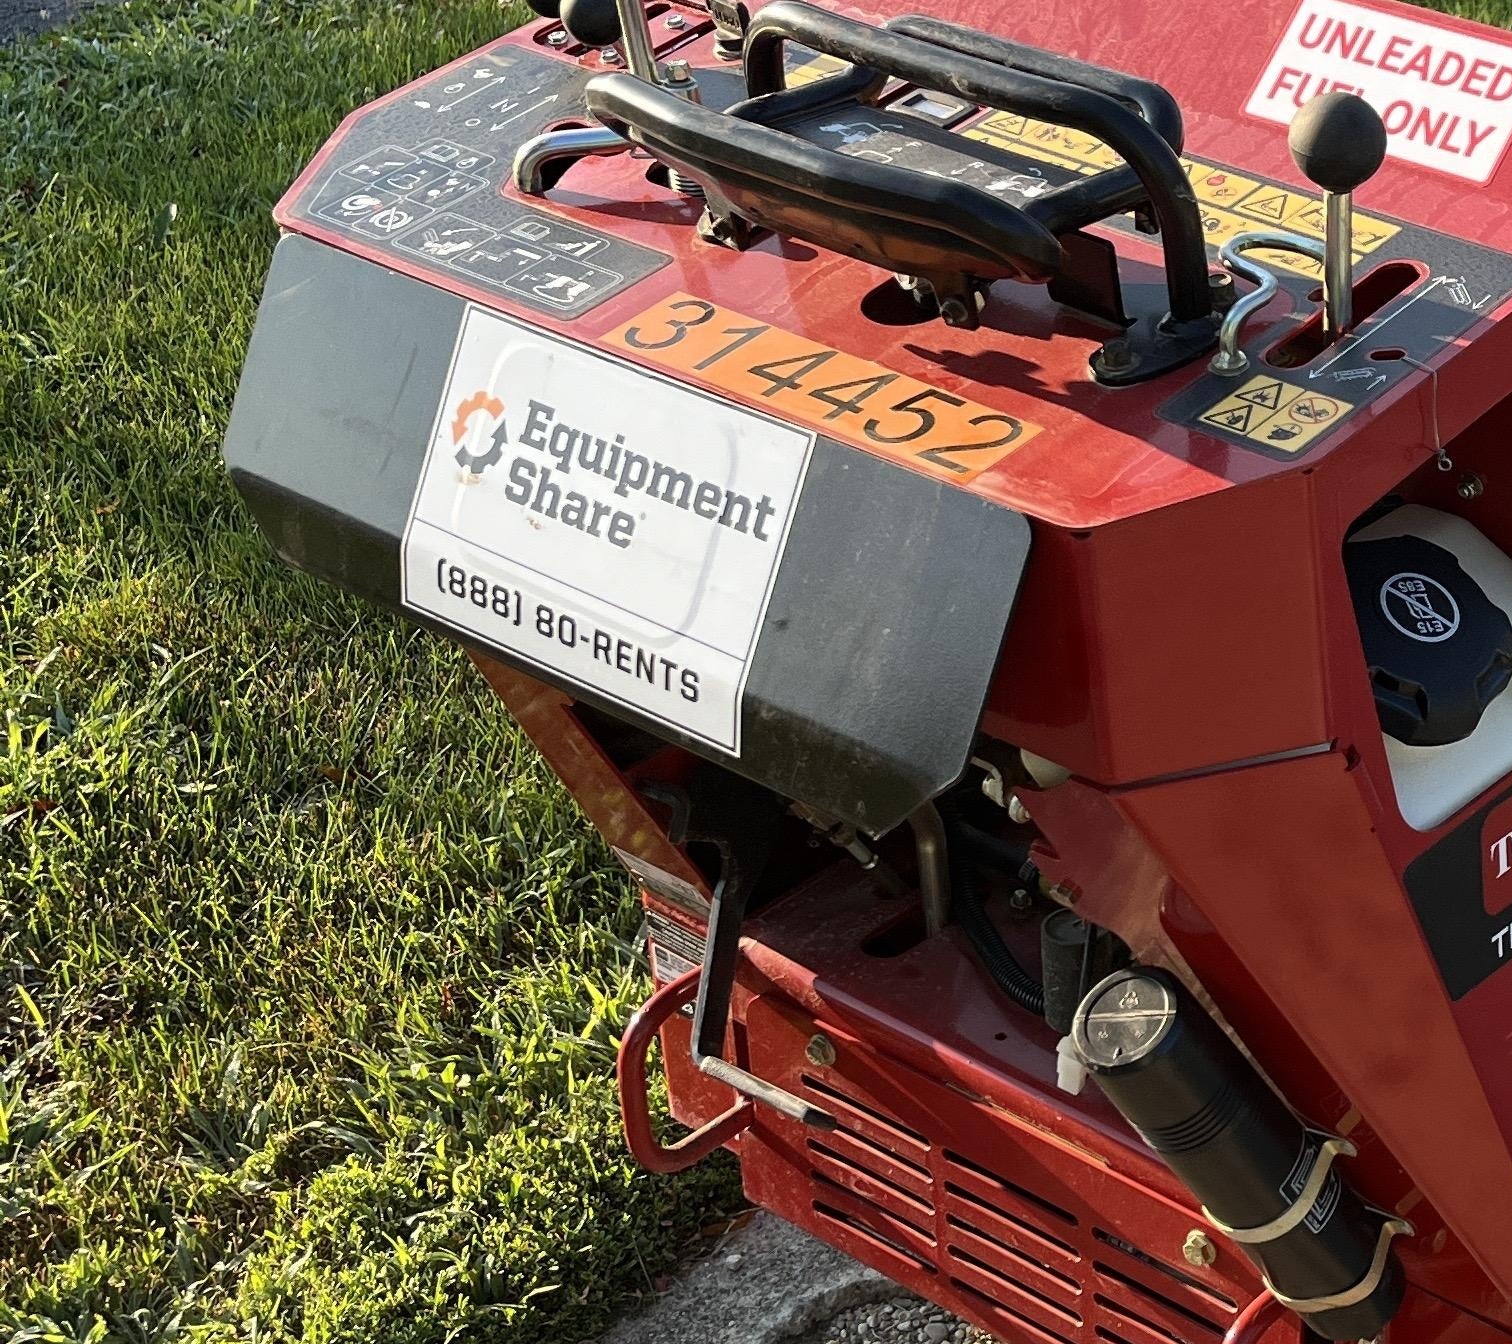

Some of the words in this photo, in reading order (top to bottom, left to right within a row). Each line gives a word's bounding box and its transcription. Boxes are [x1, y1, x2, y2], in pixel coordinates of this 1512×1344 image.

[1381, 99, 1496, 158] ONLY
[624, 300, 1023, 474] 314452
[503, 457, 638, 549] Share
[518, 399, 777, 543] Equipment
[436, 557, 522, 627] (888)
[535, 605, 701, 704] 80-RENTS
[1397, 579, 1426, 593] E85
[1416, 620, 1445, 634] E15
